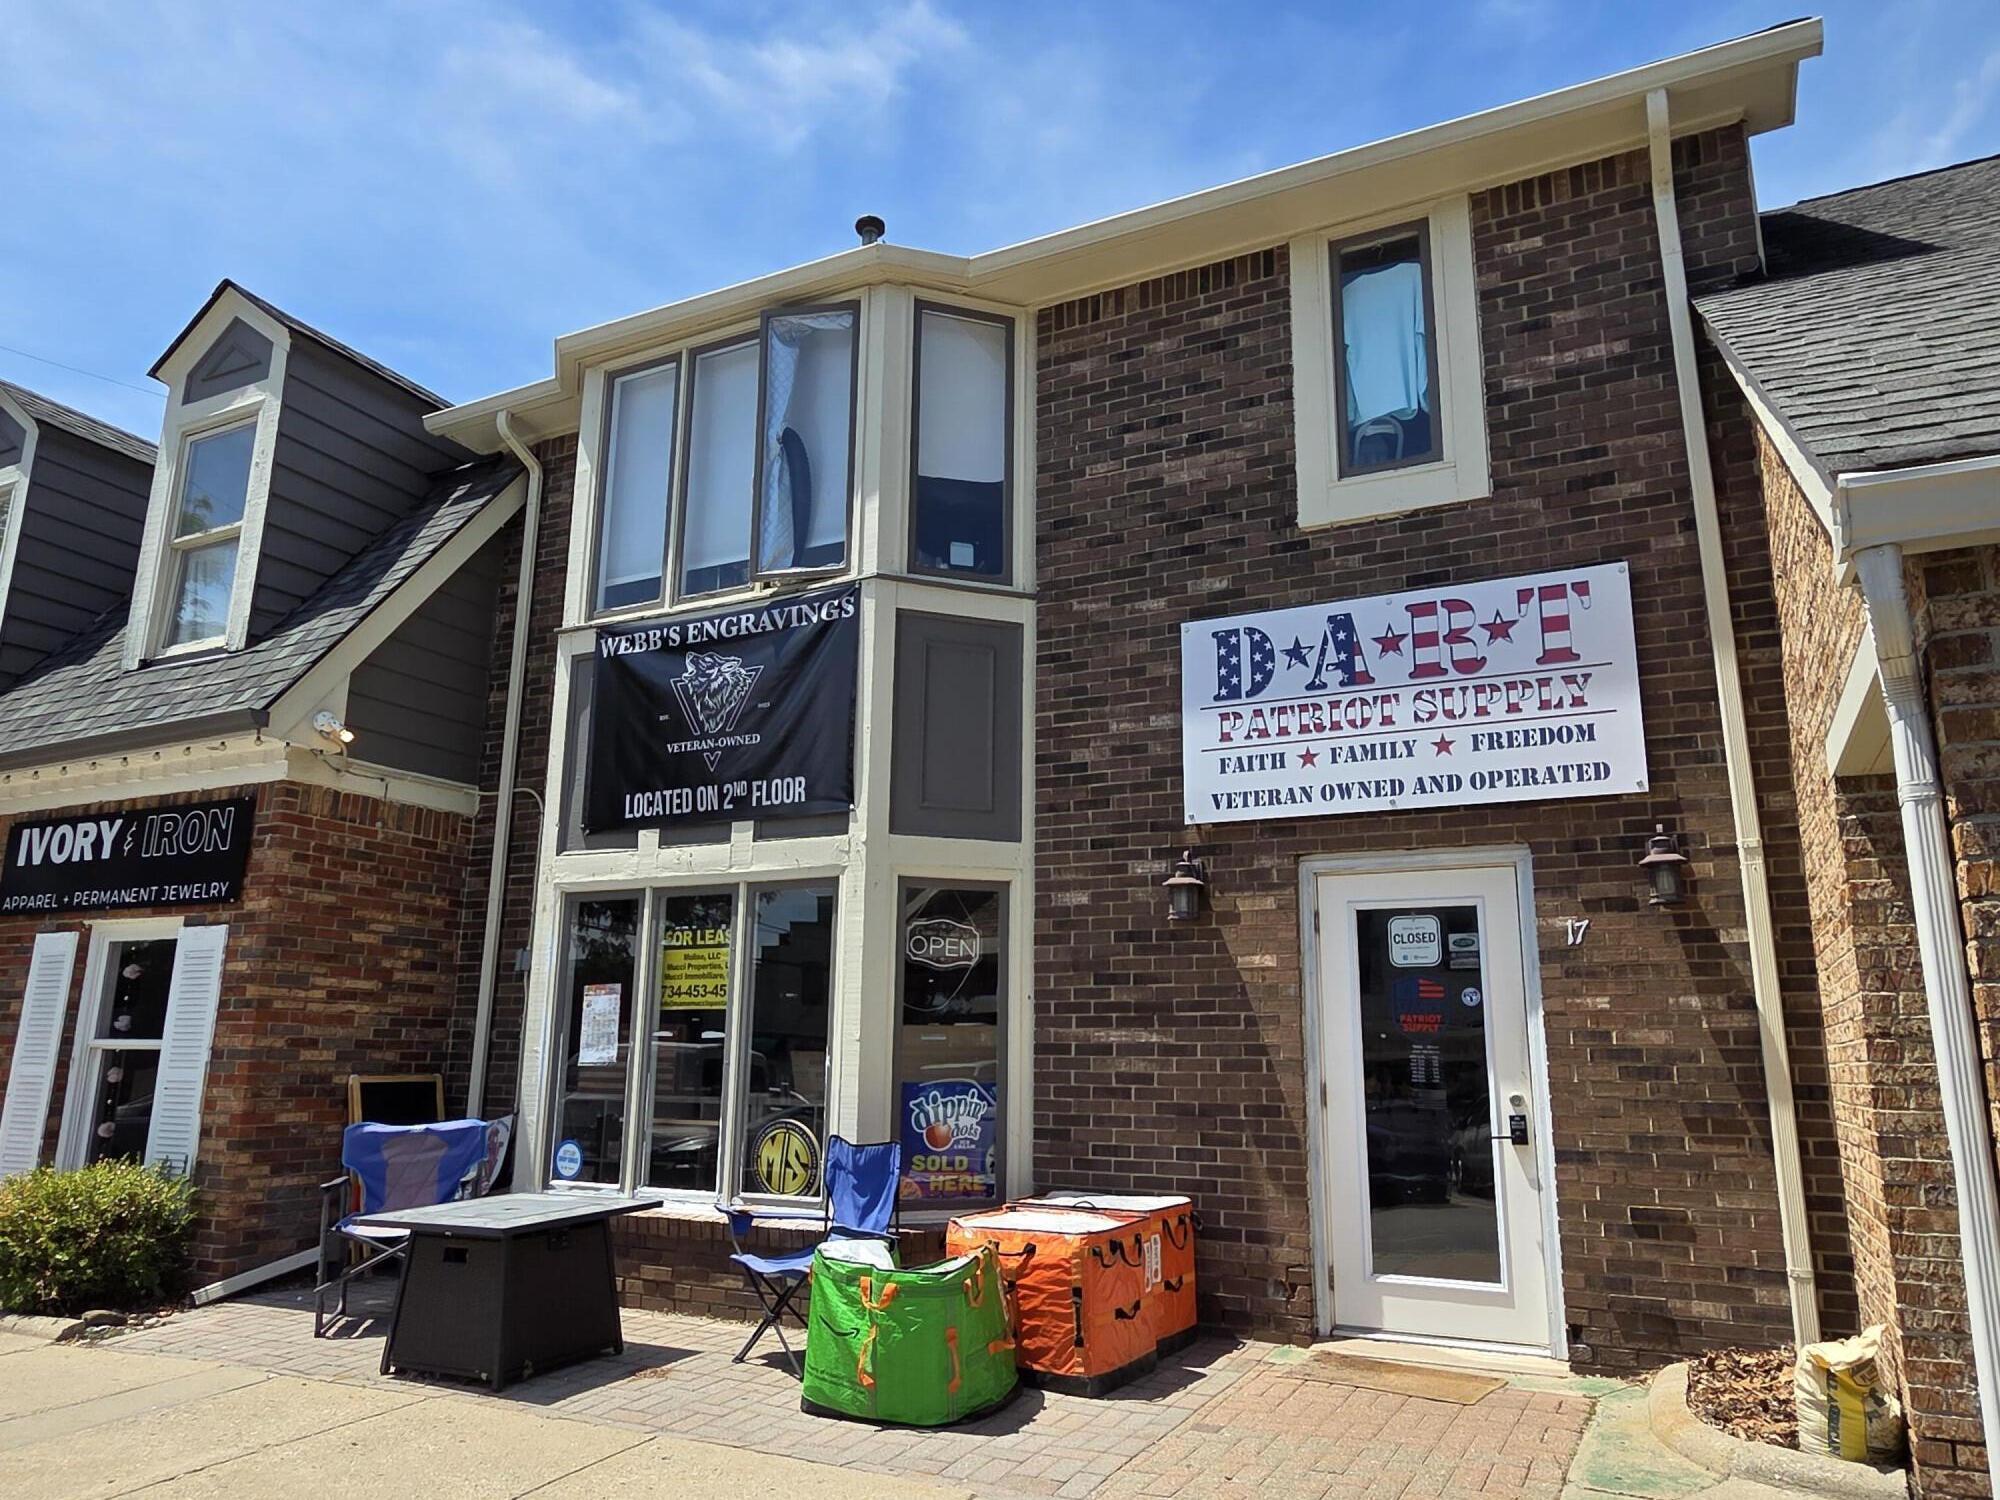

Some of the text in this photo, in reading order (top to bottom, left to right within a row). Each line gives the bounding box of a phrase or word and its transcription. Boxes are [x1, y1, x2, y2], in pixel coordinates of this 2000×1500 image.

[600, 596, 856, 658] WEBB'S ENGRAVINGS
[1219, 672, 1593, 742] PATRIOT SUPPLY
[666, 733, 761, 754] VETERAN-OWNED
[1219, 723, 1597, 774] FAITH FAMILY FREEDOM
[1210, 761, 1612, 811] VETERAN OWNED AND OPERATED
[625, 776, 806, 819] LOCATED ON 2ND FLOOR
[17, 819, 123, 866] IVORY
[141, 807, 235, 857] IRON
[2, 893, 58, 911] APPAREL
[73, 886, 158, 906] PERMANENT
[161, 881, 229, 900] JEWELRY
[665, 929, 692, 946] OR
[1394, 932, 1436, 944] CLOSED
[1568, 919, 1588, 946] 17
[708, 952, 721, 960] LLC
[910, 935, 976, 957] OPEN
[1400, 1014, 1442, 1022] PATRIOT
[952, 1120, 980, 1140] dots
[911, 1155, 969, 1172] SOLD
[929, 1175, 987, 1192] HERE
